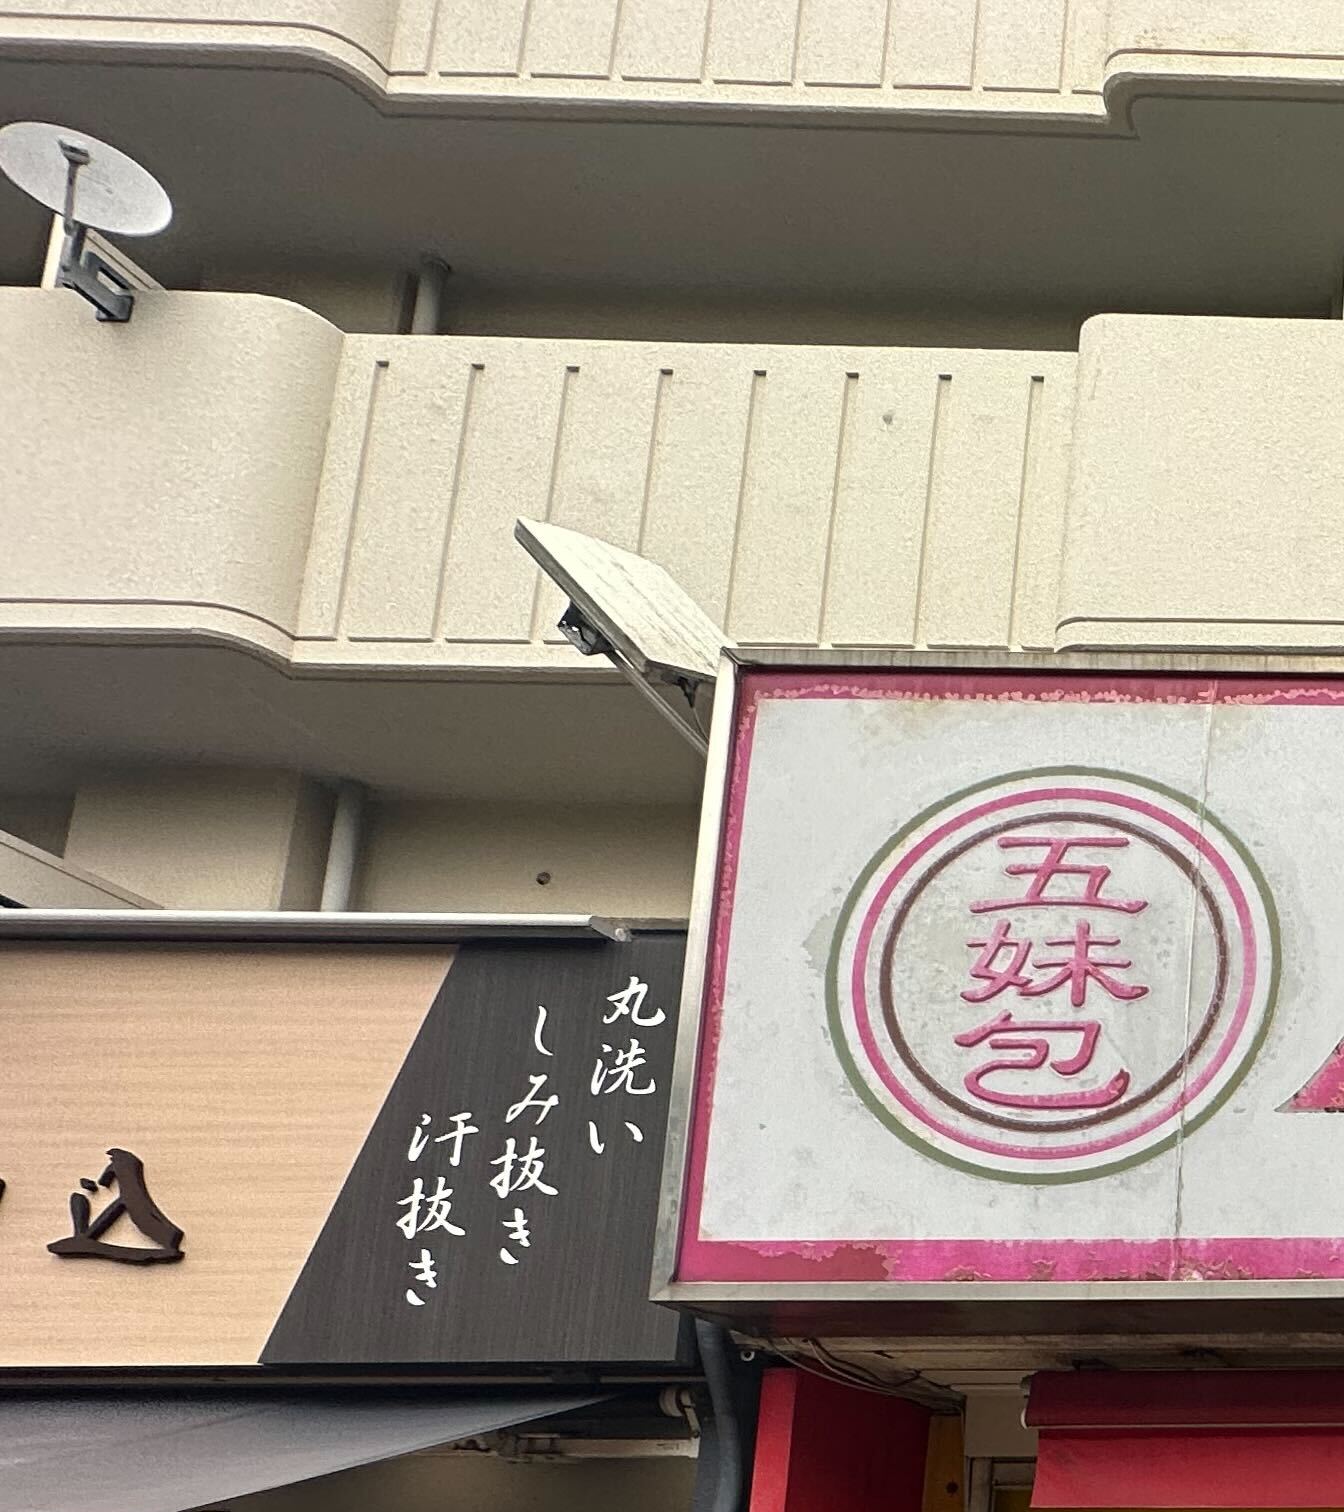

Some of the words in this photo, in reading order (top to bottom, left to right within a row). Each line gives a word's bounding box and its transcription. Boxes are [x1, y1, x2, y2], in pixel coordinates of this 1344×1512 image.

[589, 975, 665, 1154] 丸洗い
[954, 837, 1150, 1109] 五妹包
[396, 1112, 480, 1306] 汗抜き
[489, 1005, 560, 1265] しみ抜き
